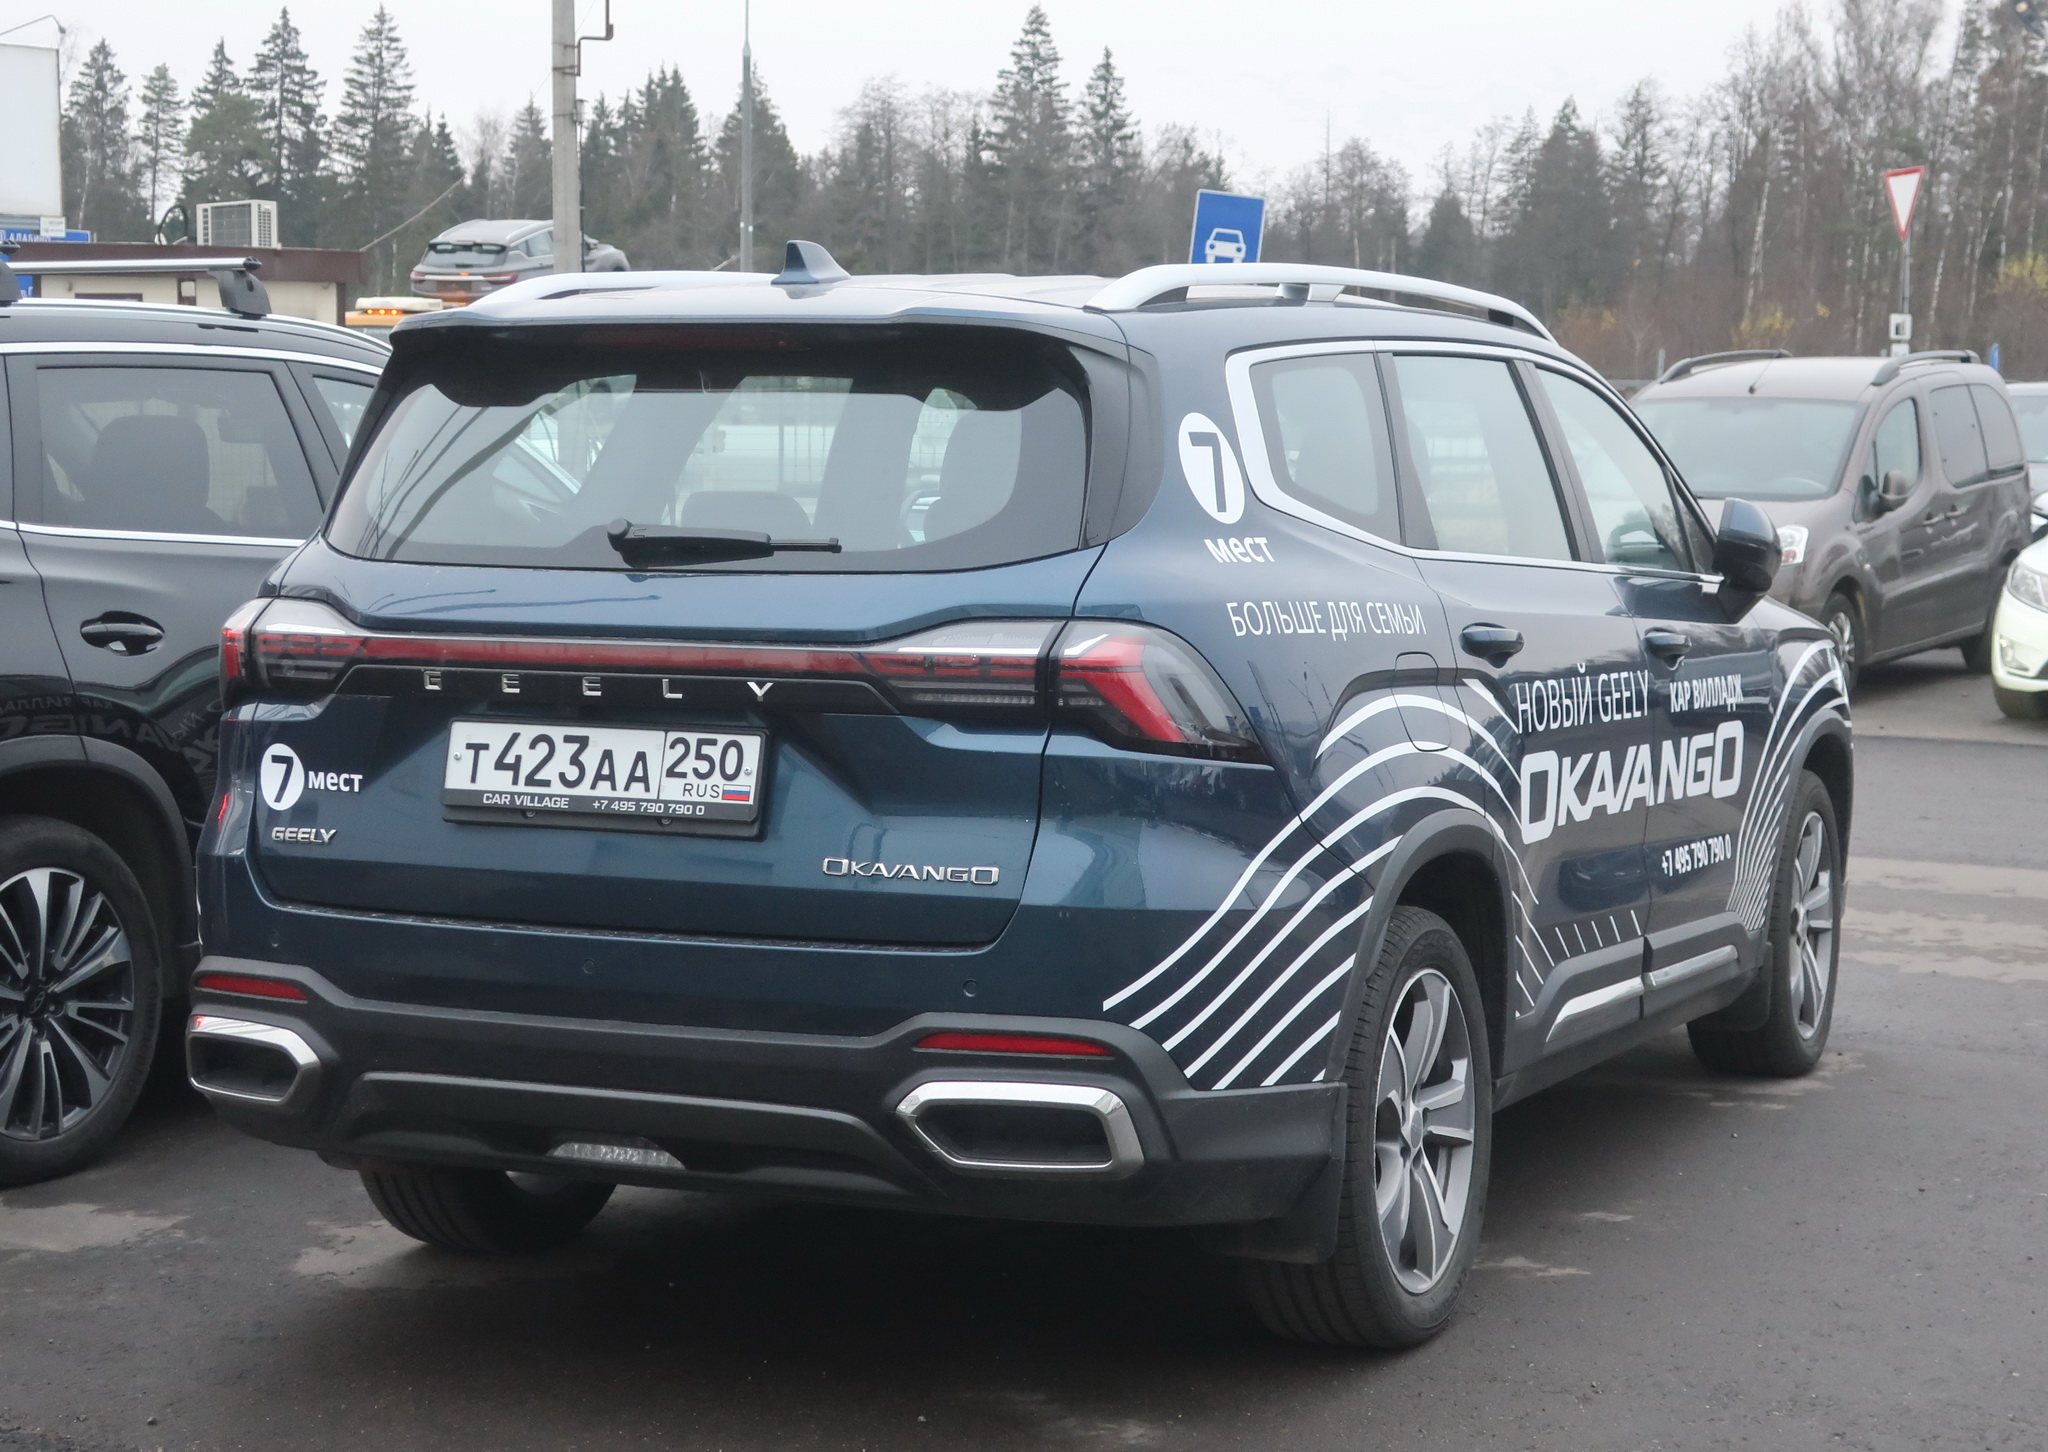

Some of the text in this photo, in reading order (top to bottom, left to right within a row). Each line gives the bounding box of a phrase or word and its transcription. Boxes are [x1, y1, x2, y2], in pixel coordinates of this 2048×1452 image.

[1188, 431, 1227, 513] 7
[1204, 537, 1275, 563] мест
[1226, 601, 1427, 642] БОЛЬШЕ ДЛЯ СЕМЬИ
[423, 670, 774, 702] GEELY
[1515, 662, 1649, 734] НОВЫЙ GEELY
[1670, 674, 1744, 713] КАР ВИЛЛАДЖ
[271, 754, 363, 804] 7 мест
[665, 737, 744, 781] 250
[682, 783, 720, 799] RUS
[1520, 719, 1745, 845] OKAVANGO
[482, 793, 705, 815] CAR VILLAGE +7 495 790 790 0
[271, 826, 338, 845] GEELY
[1661, 833, 1731, 877] +7 495 790 790 0
[822, 857, 1000, 885] OKAVANGO
